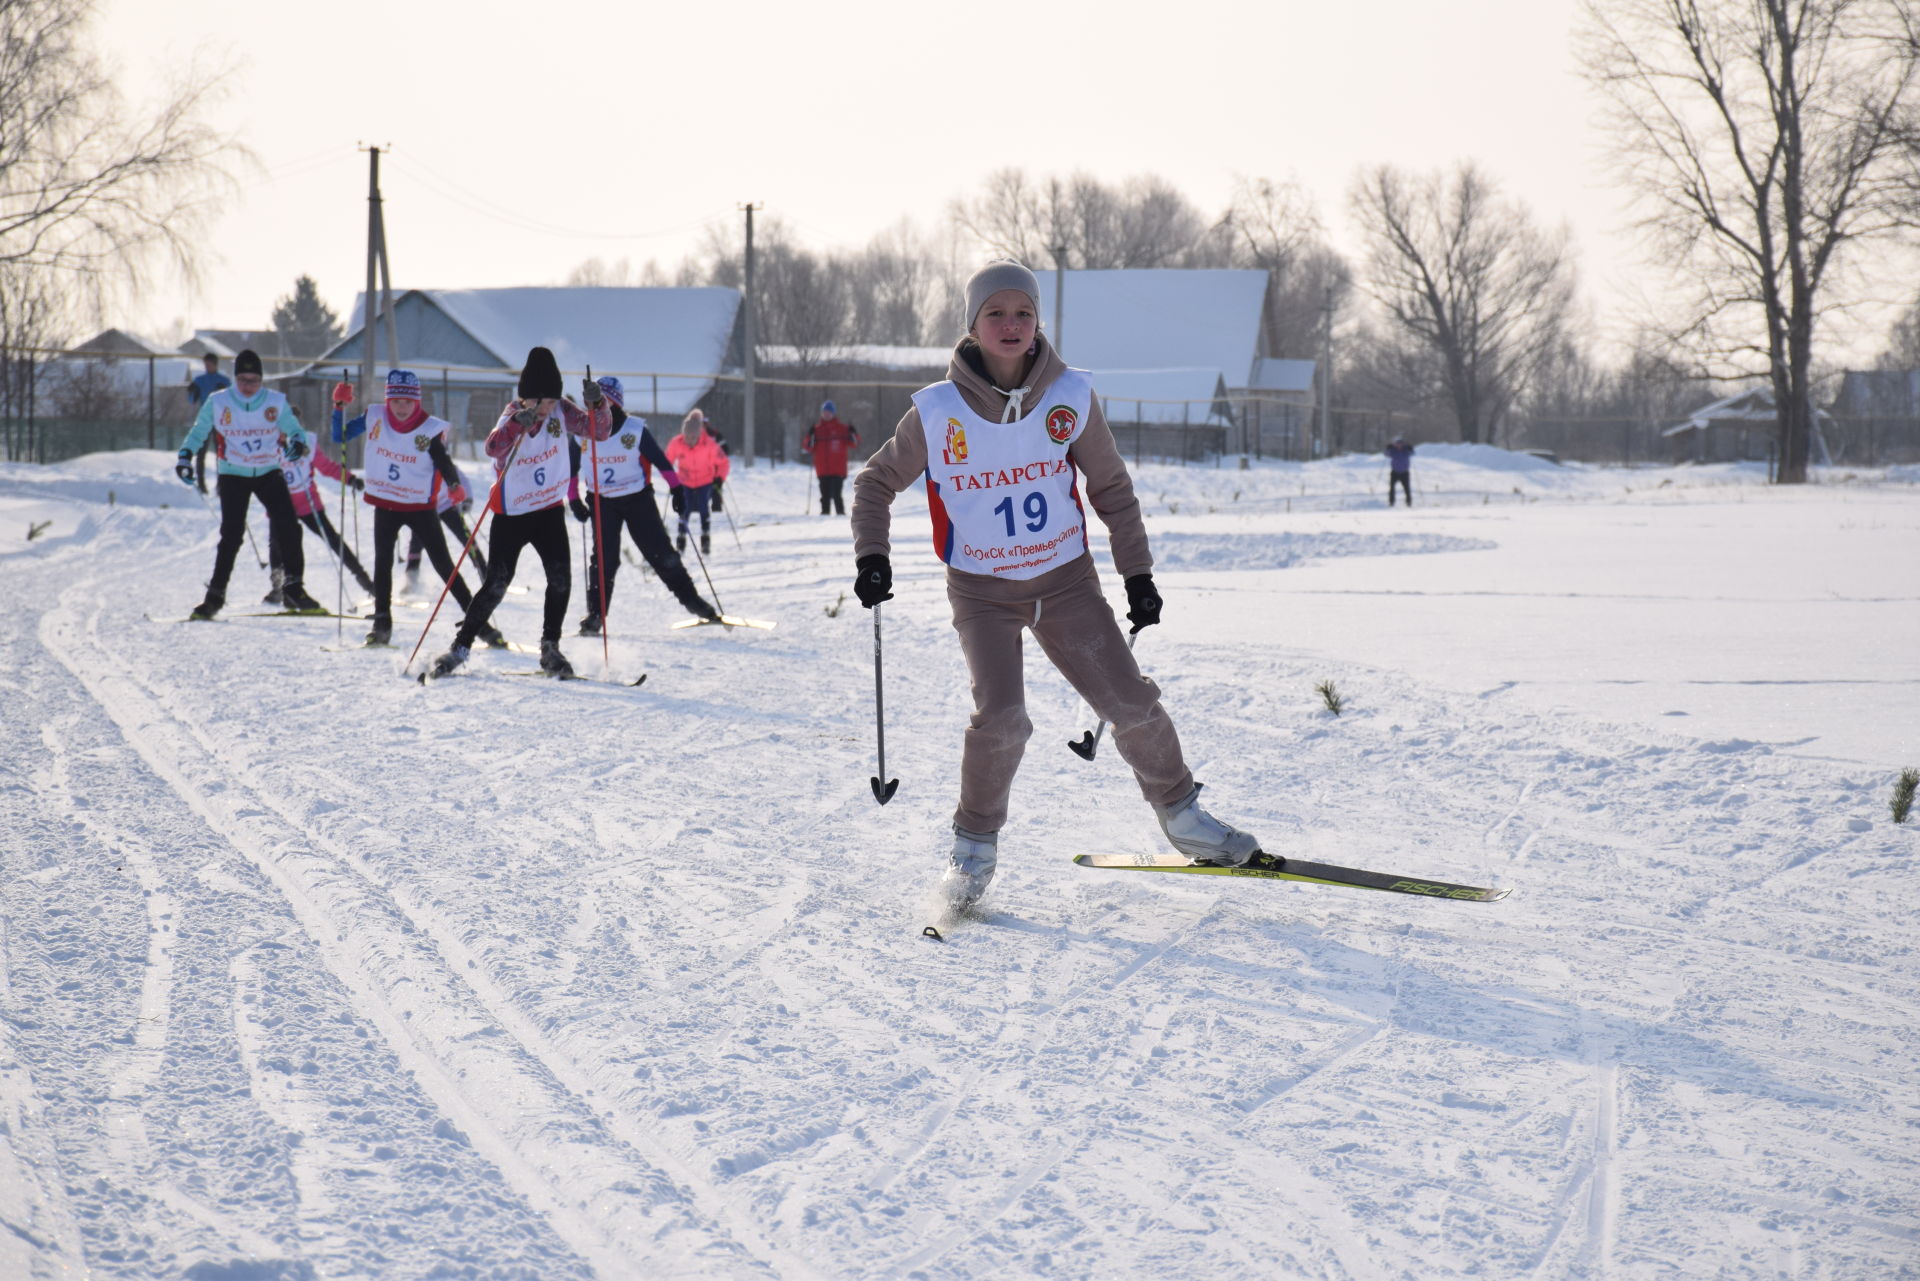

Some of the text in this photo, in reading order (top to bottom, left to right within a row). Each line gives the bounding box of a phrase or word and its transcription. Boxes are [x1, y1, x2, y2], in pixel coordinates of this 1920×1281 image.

[242, 439, 262, 452] 17
[377, 447, 417, 464] РОССИЯ
[517, 445, 559, 466] РОССИЯ
[388, 463, 401, 481] 5
[534, 467, 546, 486] 6
[603, 467, 616, 484] 2
[994, 491, 1048, 537] 19
[1231, 868, 1280, 879] FISCHER
[1390, 881, 1487, 900] FISCHER
